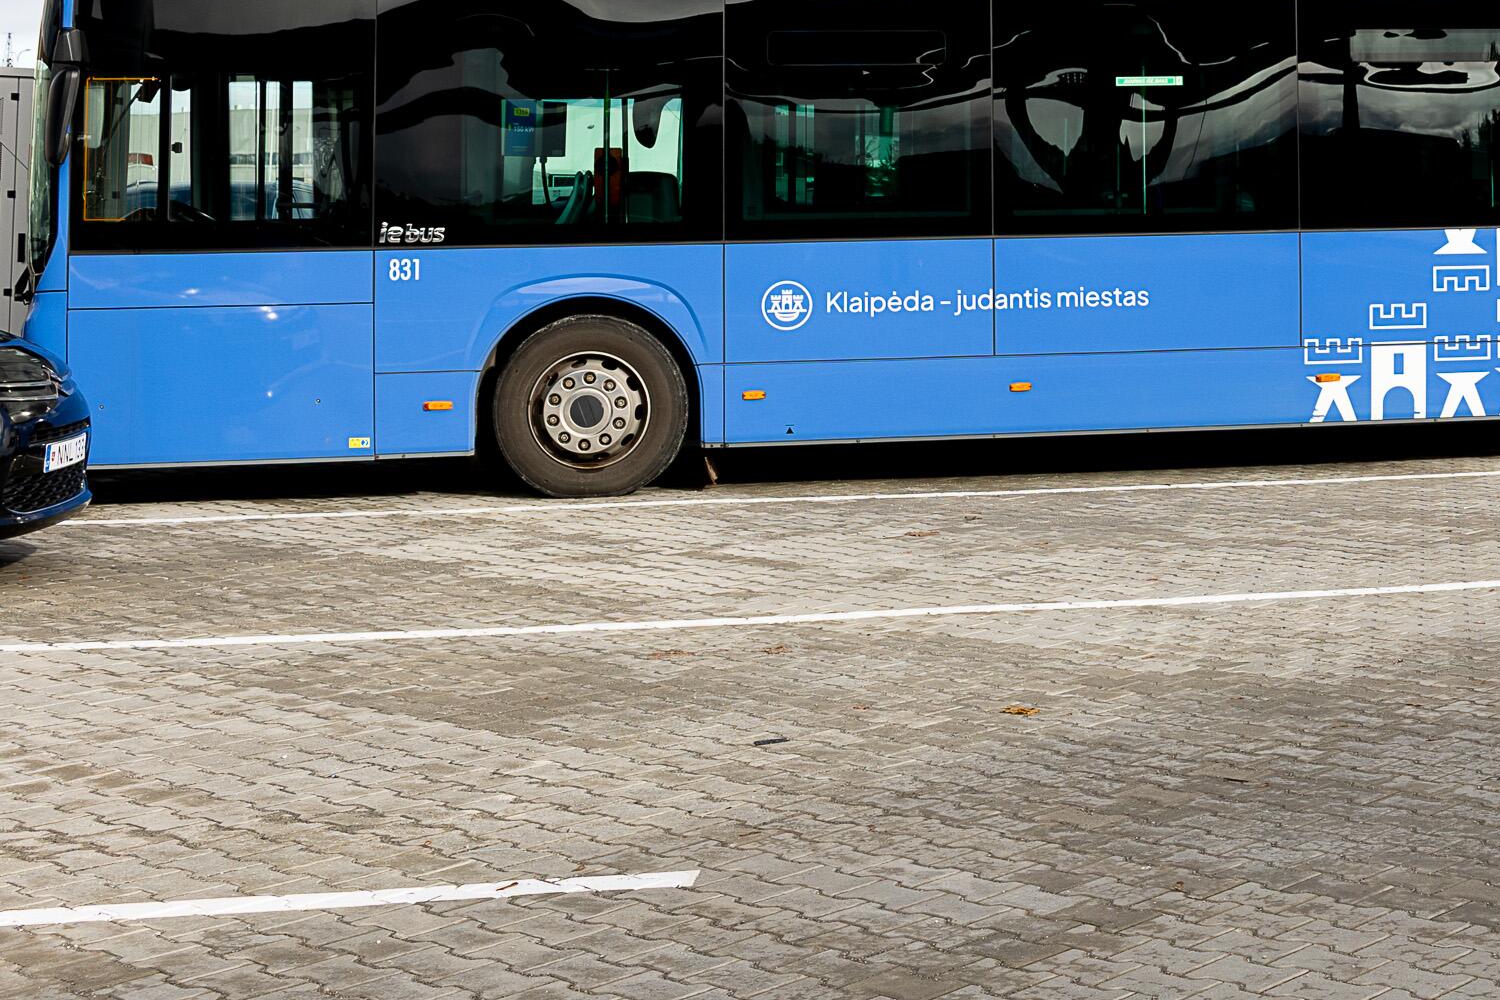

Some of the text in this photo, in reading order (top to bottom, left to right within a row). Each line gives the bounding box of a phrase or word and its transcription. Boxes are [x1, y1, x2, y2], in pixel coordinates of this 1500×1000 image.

[389, 259, 420, 281] 831
[826, 290, 935, 318] Klaipėda
[953, 288, 1051, 316] judantis
[1057, 286, 1150, 308] miestas
